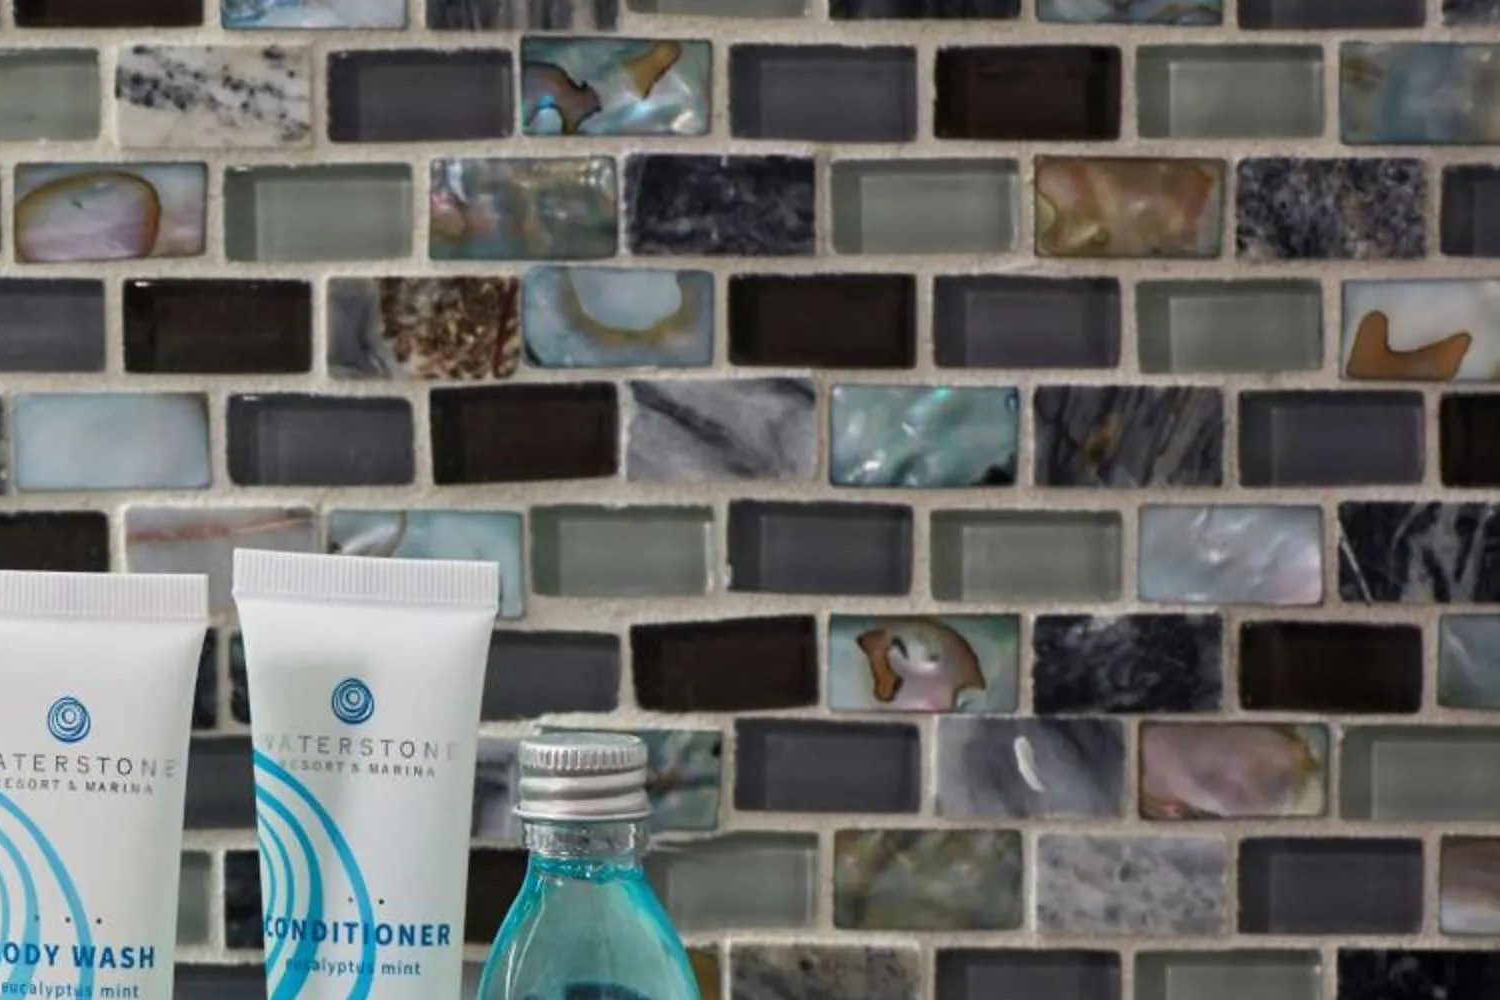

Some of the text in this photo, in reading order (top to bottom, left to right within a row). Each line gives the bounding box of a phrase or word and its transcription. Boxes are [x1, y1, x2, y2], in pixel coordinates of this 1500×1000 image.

[369, 763, 436, 778] MARINA
[68, 780, 78, 791] &
[86, 781, 153, 795] MARINA
[265, 918, 451, 947] CONDITIONER
[72, 945, 156, 969] WASH
[381, 961, 421, 976] mint
[1, 982, 139, 999] eucalyptus mint
